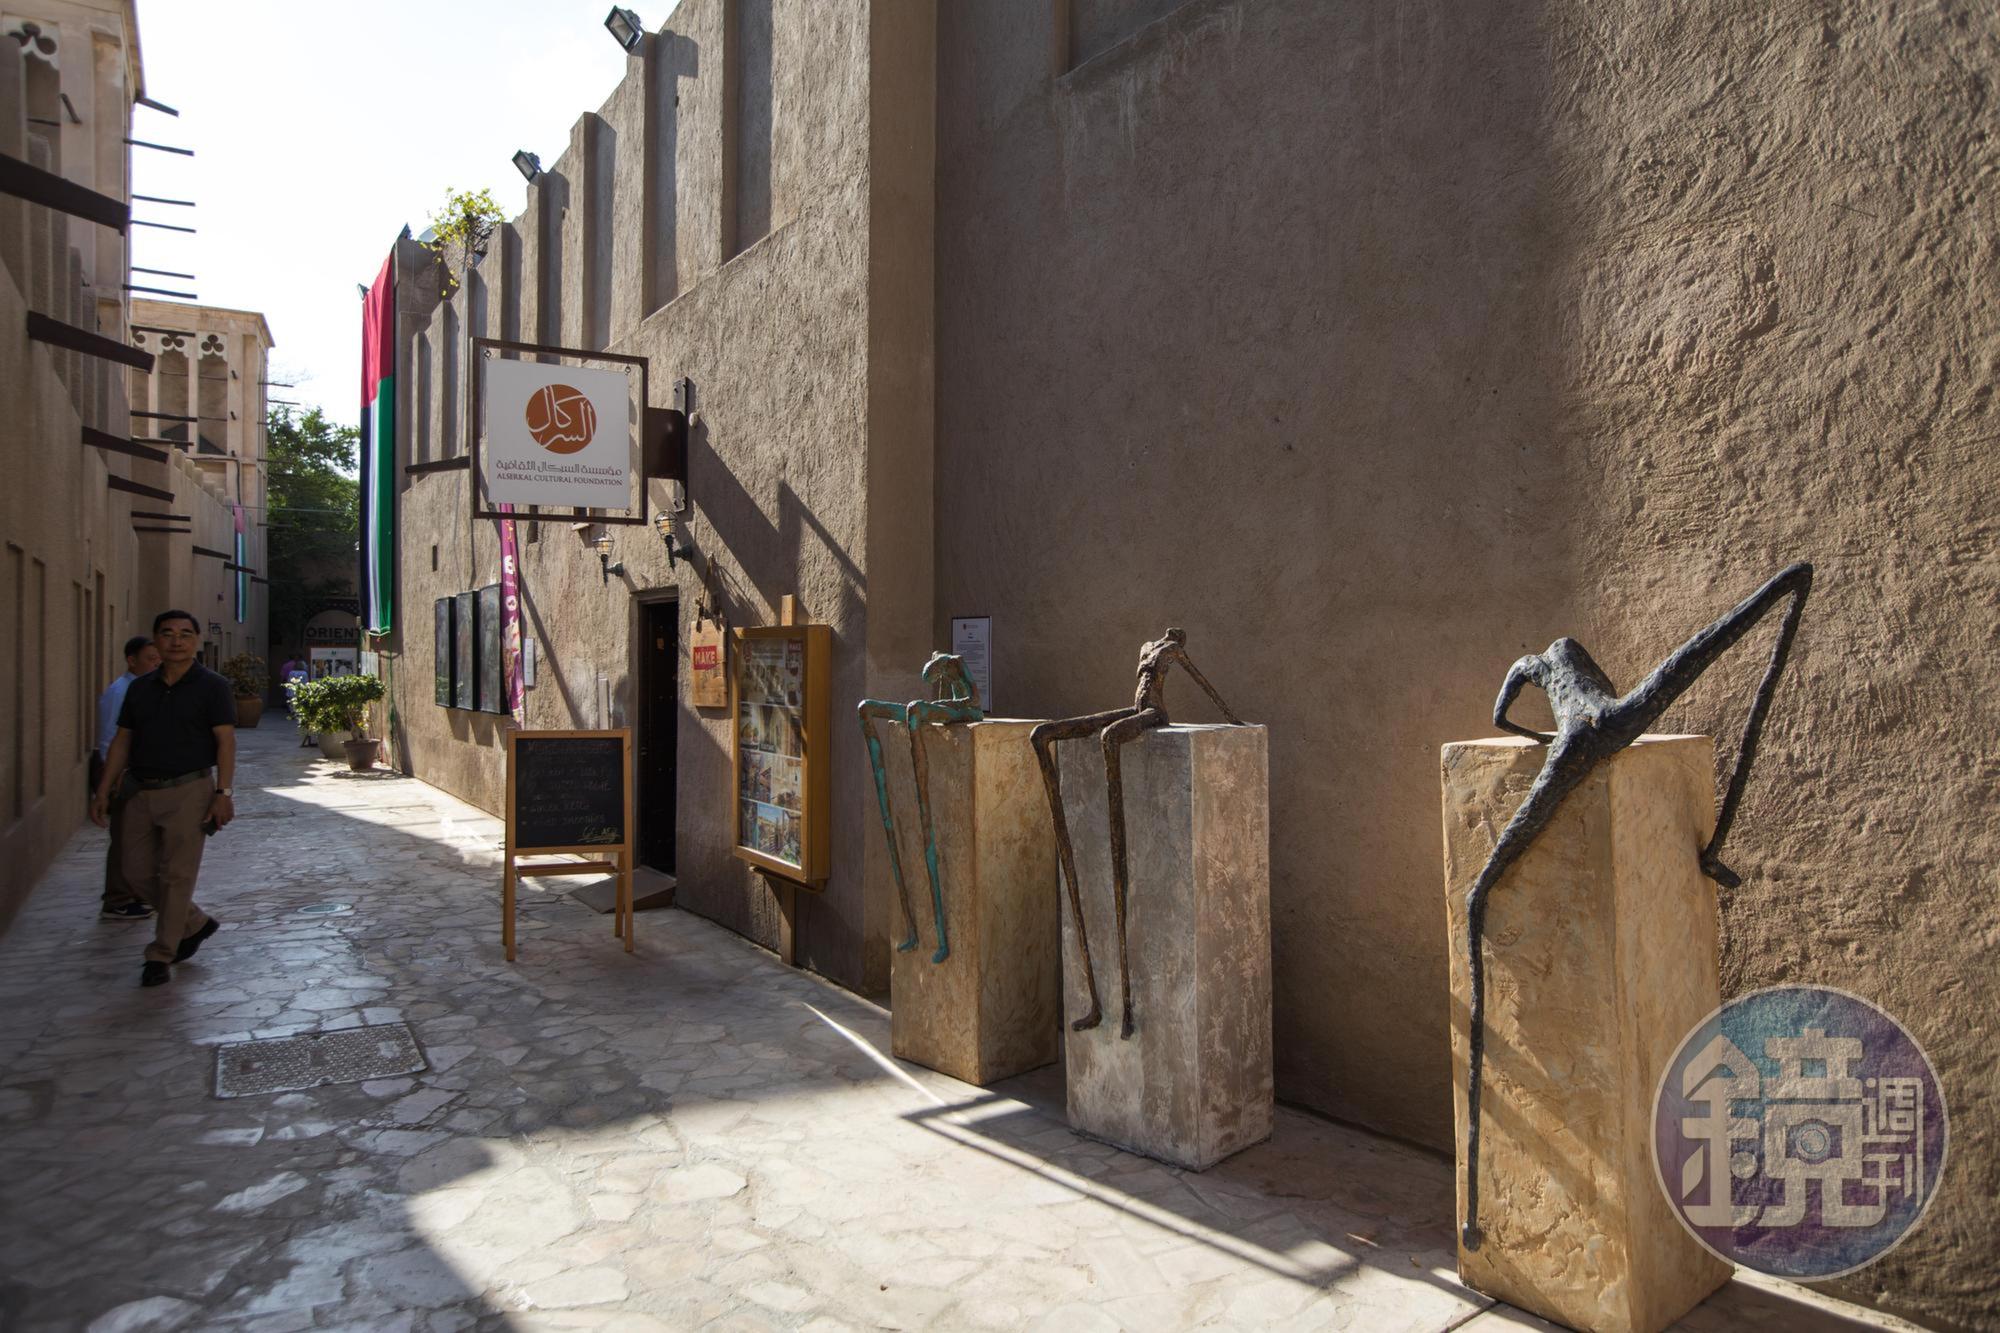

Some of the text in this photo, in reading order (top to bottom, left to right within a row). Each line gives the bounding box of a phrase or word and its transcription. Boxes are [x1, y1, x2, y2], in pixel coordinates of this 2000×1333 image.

[496, 473, 623, 486] ALSERKAL CULTURAL FOUNDATION
[695, 651, 715, 665] MAKE
